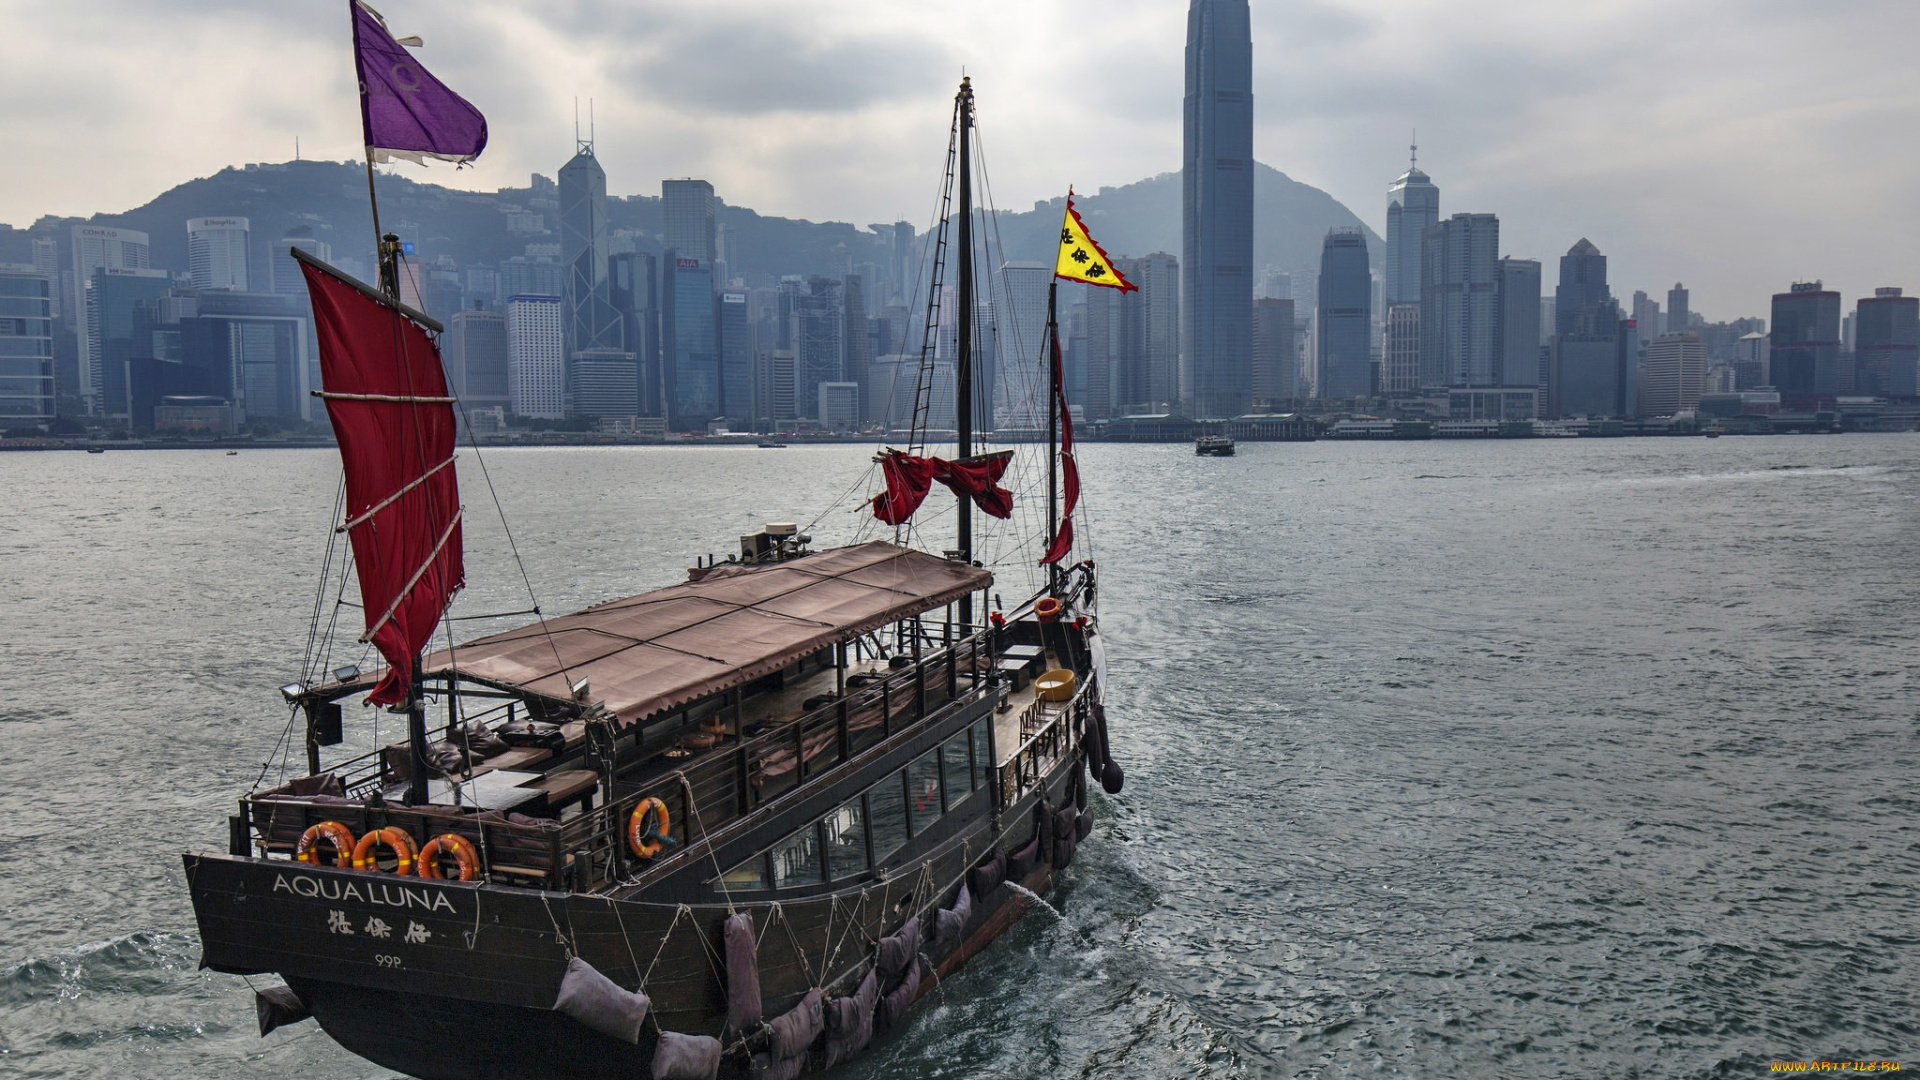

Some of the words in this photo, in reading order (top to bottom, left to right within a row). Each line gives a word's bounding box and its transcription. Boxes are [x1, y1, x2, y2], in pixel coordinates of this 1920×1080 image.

[82, 228, 118, 238] CONRAD
[679, 260, 697, 268] AIA
[273, 873, 365, 903] AQUA
[367, 882, 457, 914] LUNA
